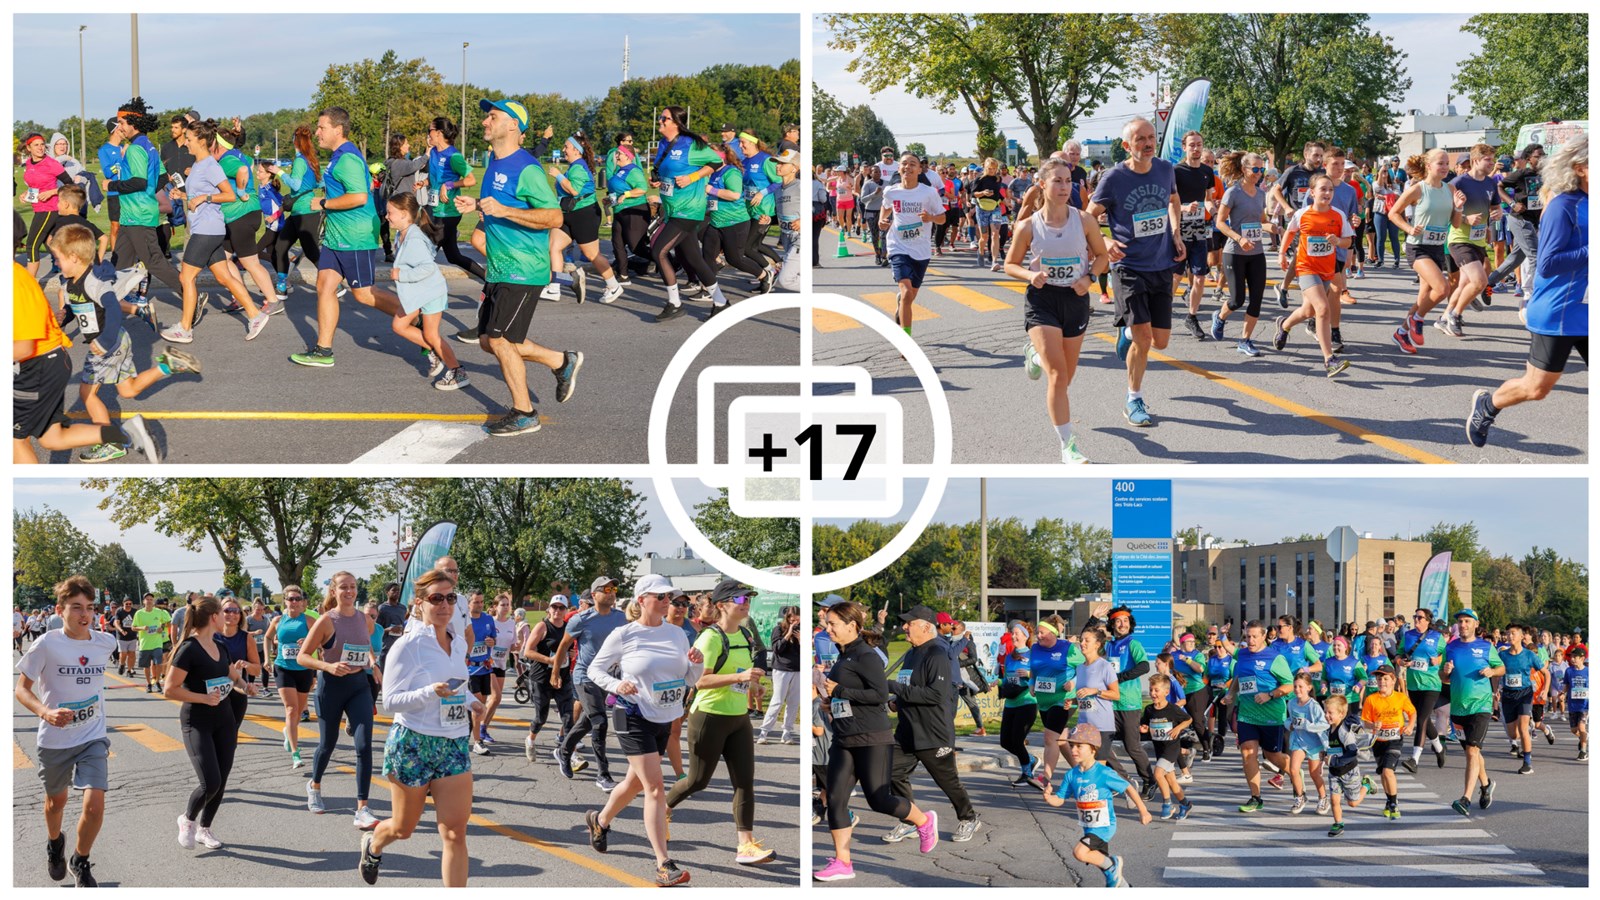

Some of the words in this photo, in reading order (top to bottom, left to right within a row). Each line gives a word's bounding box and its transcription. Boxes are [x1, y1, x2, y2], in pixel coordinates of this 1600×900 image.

[1141, 218, 1164, 232] 353
[903, 228, 920, 239] 464
[1246, 229, 1260, 238] 413
[1428, 232, 1446, 240] 516
[1312, 243, 1332, 252] 326
[1048, 266, 1075, 280] 362
[1115, 482, 1134, 492] 400
[1126, 542, 1156, 550] Québec
[348, 652, 365, 662] 511
[1038, 681, 1052, 690] 253
[660, 688, 682, 702] 436
[1155, 728, 1166, 738] 18
[1380, 729, 1396, 738] 756
